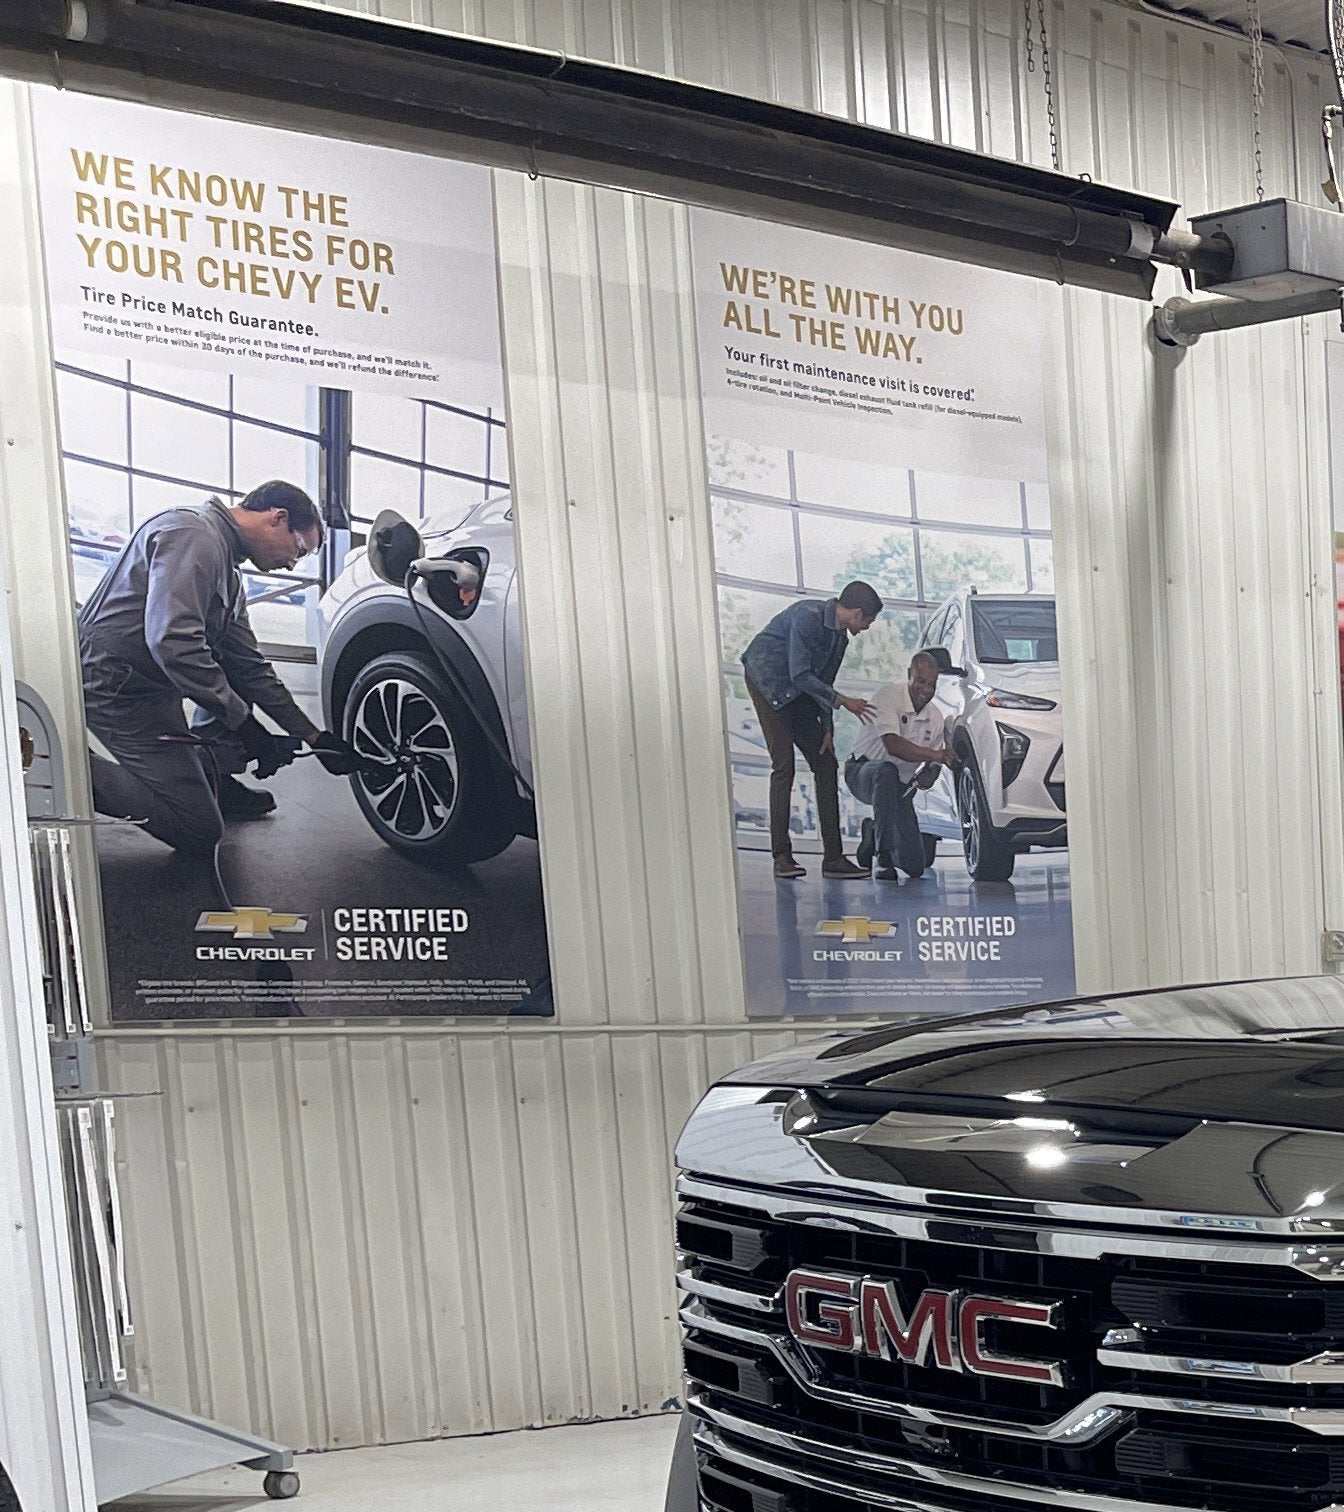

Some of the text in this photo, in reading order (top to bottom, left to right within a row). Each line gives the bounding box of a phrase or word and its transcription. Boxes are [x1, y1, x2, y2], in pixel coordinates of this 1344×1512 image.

[70, 148, 350, 228] WE KNOW THE
[75, 191, 395, 275] RIGHT TIRES FOR
[76, 233, 390, 315] YOUR CHEVY EV.
[719, 262, 964, 335] WE'RE WITH YOU
[80, 285, 319, 337] Tire Price Match Guarantee.
[723, 300, 923, 364] ALL THE WAY.
[82, 311, 118, 325] Provide
[120, 318, 131, 327] us
[134, 320, 154, 331] with
[164, 324, 192, 336] better
[194, 330, 226, 343] eligible
[228, 335, 251, 347] price
[254, 339, 262, 347] at
[264, 338, 278, 349] the
[281, 341, 300, 352] time
[302, 345, 312, 354] of
[313, 347, 355, 360] purchase,
[357, 352, 372, 362] and
[394, 358, 421, 369] match
[83, 323, 104, 334] Find
[114, 328, 142, 340] better
[145, 334, 168, 346] price
[171, 337, 198, 349] within
[214, 343, 234, 355] days
[237, 346, 248, 356] of
[249, 349, 262, 359] the
[265, 353, 307, 366] purchase,
[309, 358, 325, 367] and
[348, 363, 376, 374] refund
[378, 366, 392, 376] the
[724, 345, 756, 365] Your
[759, 352, 790, 371] first
[793, 363, 876, 387] maintenance
[879, 376, 906, 392] visit
[909, 379, 920, 394] is
[334, 908, 468, 934] CERTIFIED
[916, 916, 1016, 937] CERTIFIED
[196, 945, 316, 961] CHEVROLET
[336, 936, 449, 961] SERVICE
[813, 950, 903, 962] CHEVROLET
[917, 941, 1001, 962] SERVICE
[785, 1268, 1066, 1388] GMC
